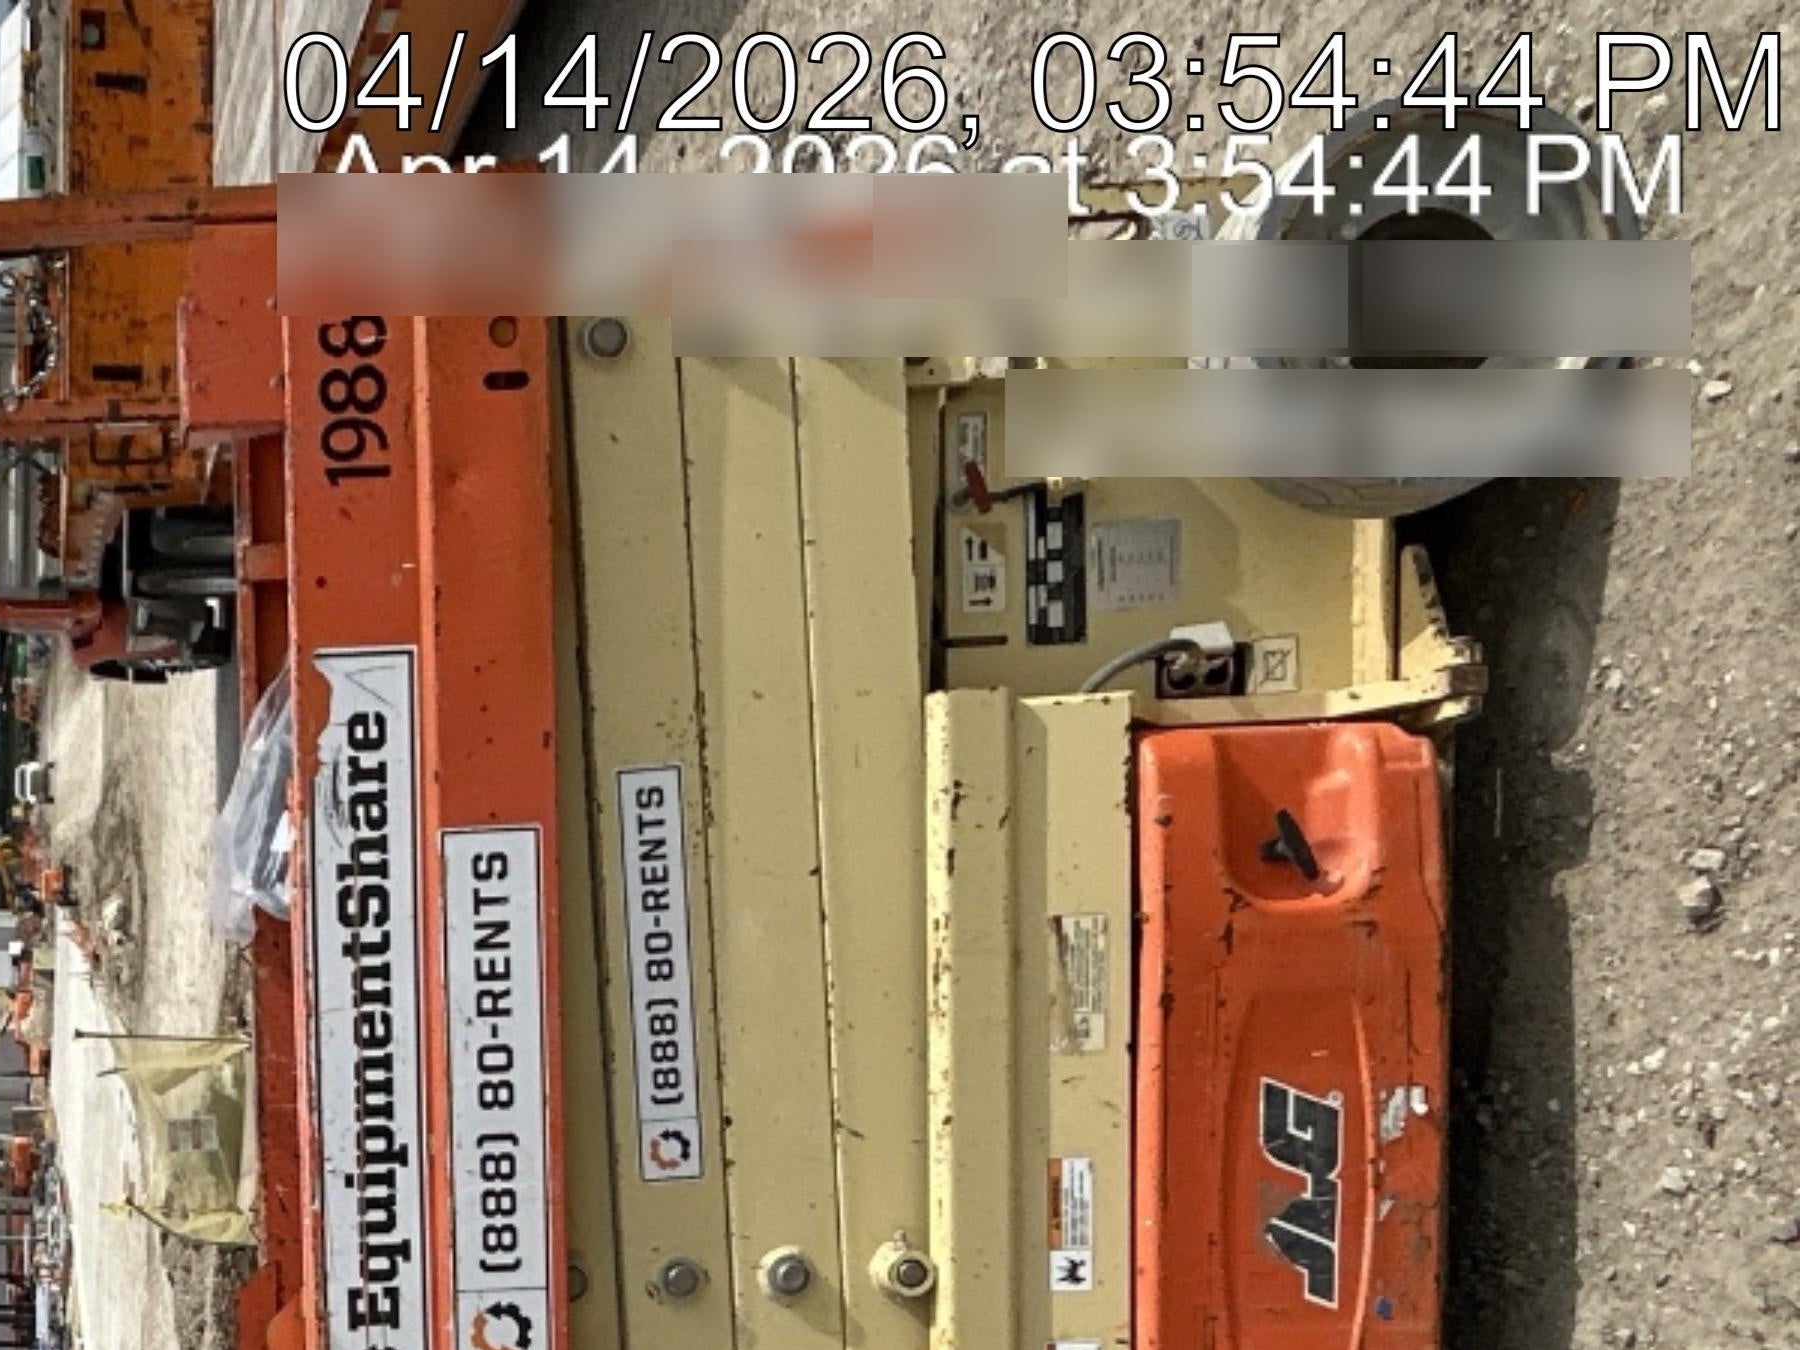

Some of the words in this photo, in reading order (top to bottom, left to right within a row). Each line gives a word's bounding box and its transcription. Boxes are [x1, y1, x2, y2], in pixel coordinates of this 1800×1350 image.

[470, 851, 515, 1111] 80-RENTS
[635, 785, 674, 982] 80-RENTS
[333, 710, 412, 1332] EquipmentShare
[647, 997, 684, 1106] (888)
[477, 1132, 521, 1274] (888)
